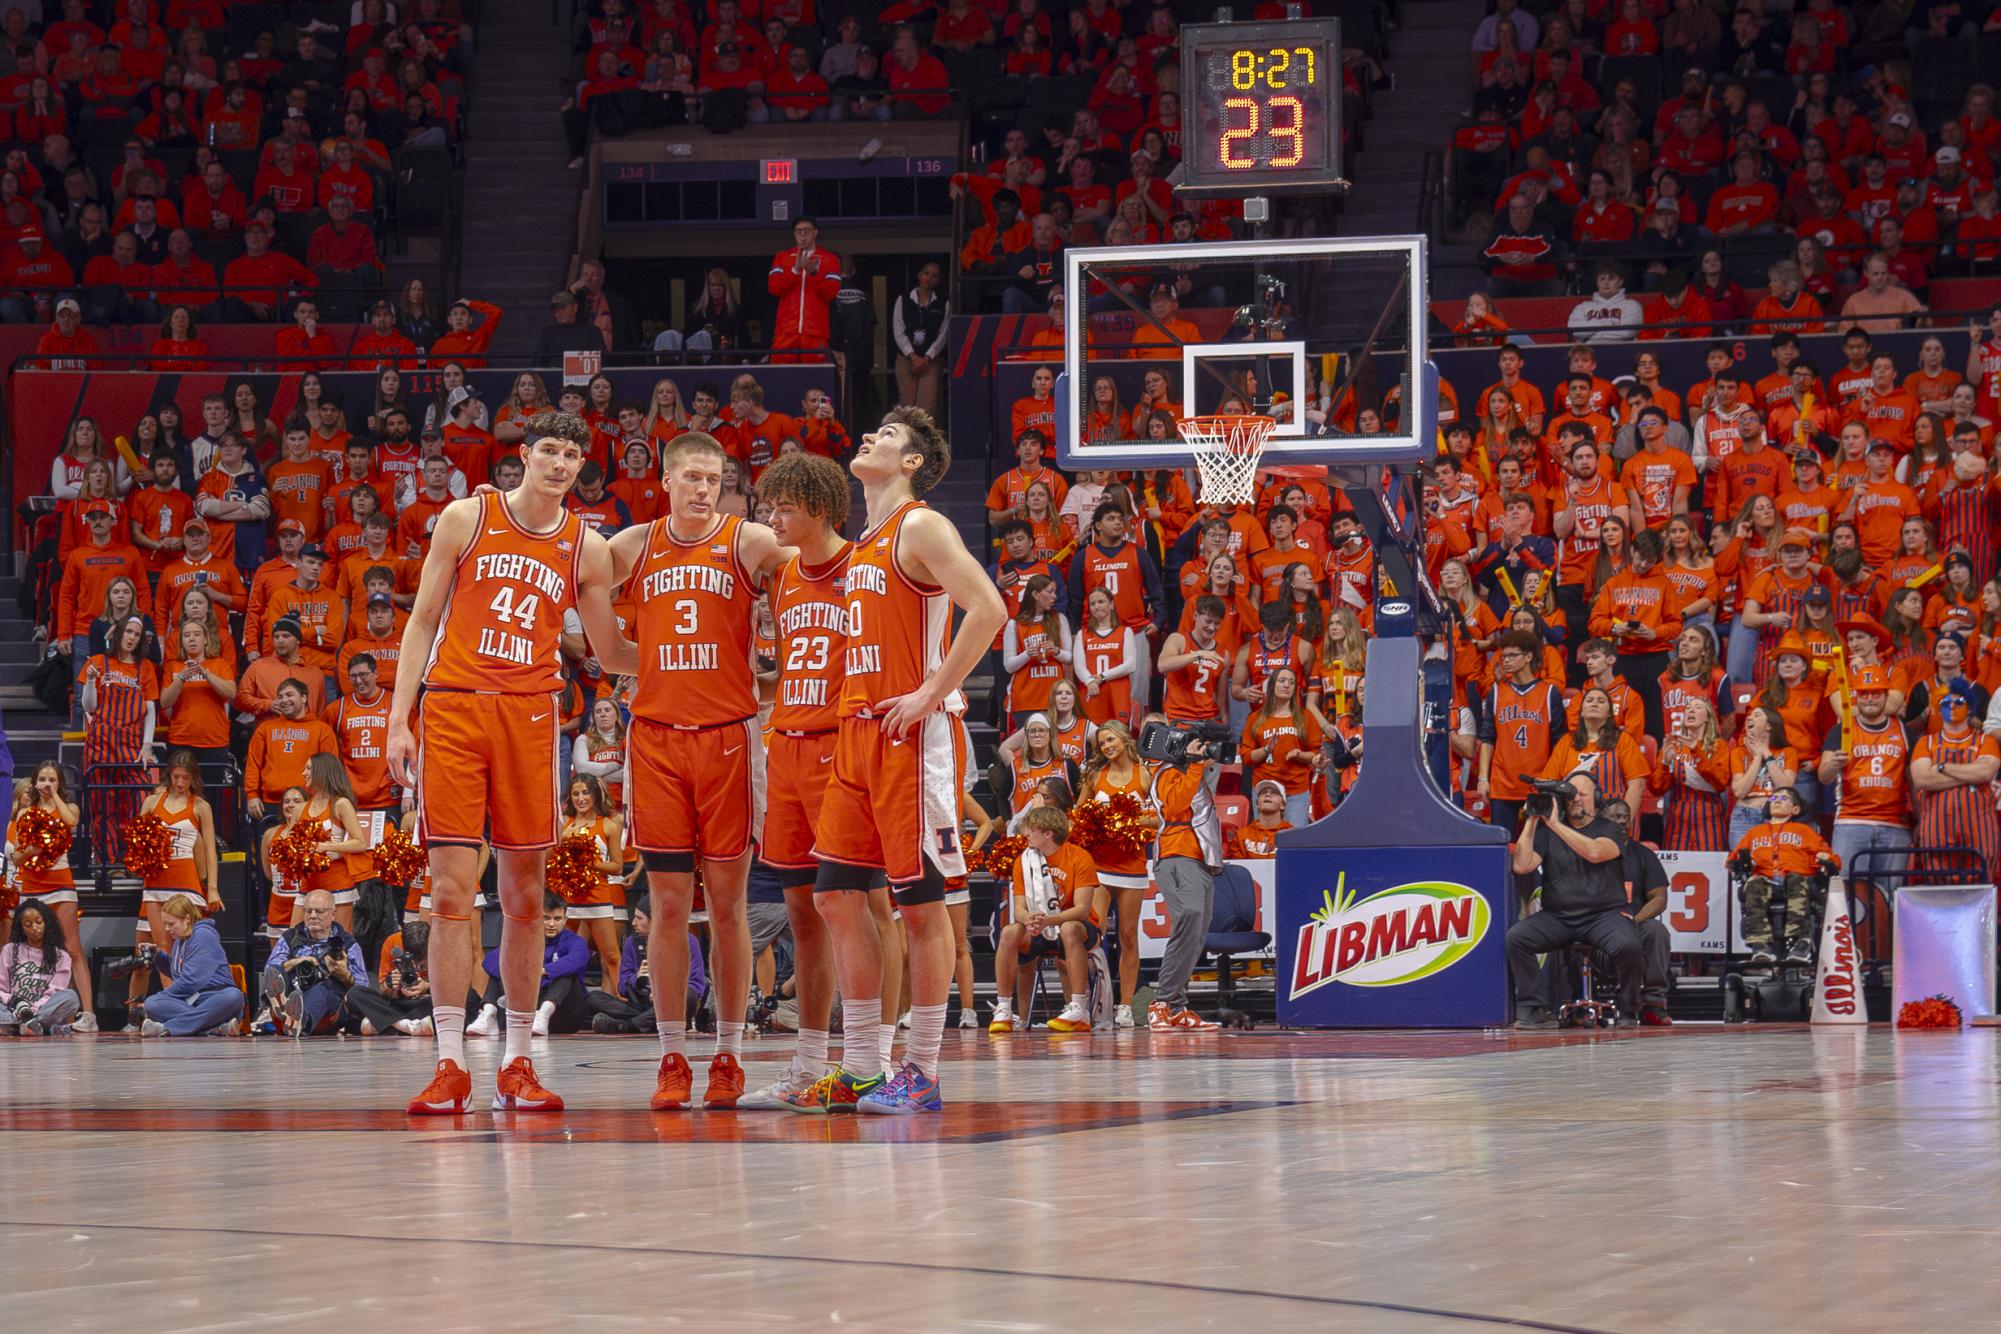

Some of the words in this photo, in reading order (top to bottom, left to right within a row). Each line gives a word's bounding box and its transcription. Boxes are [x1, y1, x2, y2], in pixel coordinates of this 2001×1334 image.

[1231, 47, 1315, 90] 8:27
[1219, 96, 1303, 169] 23
[767, 161, 792, 182] EXIT
[917, 160, 941, 173] 136
[475, 553, 566, 604] FIGHTING
[1094, 562, 1128, 572] ILLINOIS
[642, 563, 735, 603] FIGHTING
[1104, 571, 1119, 596] 0
[489, 586, 541, 632] 44
[674, 598, 699, 635] 3
[779, 601, 849, 640] FIGHTING
[477, 627, 535, 666] ILLINI
[658, 642, 719, 671] ILLINI
[786, 635, 830, 671] 23
[1086, 642, 1119, 651] ILLINOIS
[1030, 665, 1058, 679] ILLINI
[1194, 666, 1209, 694] 2
[783, 678, 829, 707] ILLINI
[346, 715, 386, 730] FIGHTING
[1499, 704, 1543, 724] Illinois
[360, 729, 371, 746] 2
[1514, 725, 1528, 748] 4
[351, 747, 381, 759] ILLINI
[1853, 744, 1901, 758] ORANGE
[1870, 756, 1885, 776] 6
[1858, 776, 1894, 789] KRUSH
[1669, 871, 1711, 933] 3
[1293, 894, 1478, 995] LIBMAN
[1700, 940, 1726, 950] KAMS
[1822, 914, 1857, 1016] Illinois
